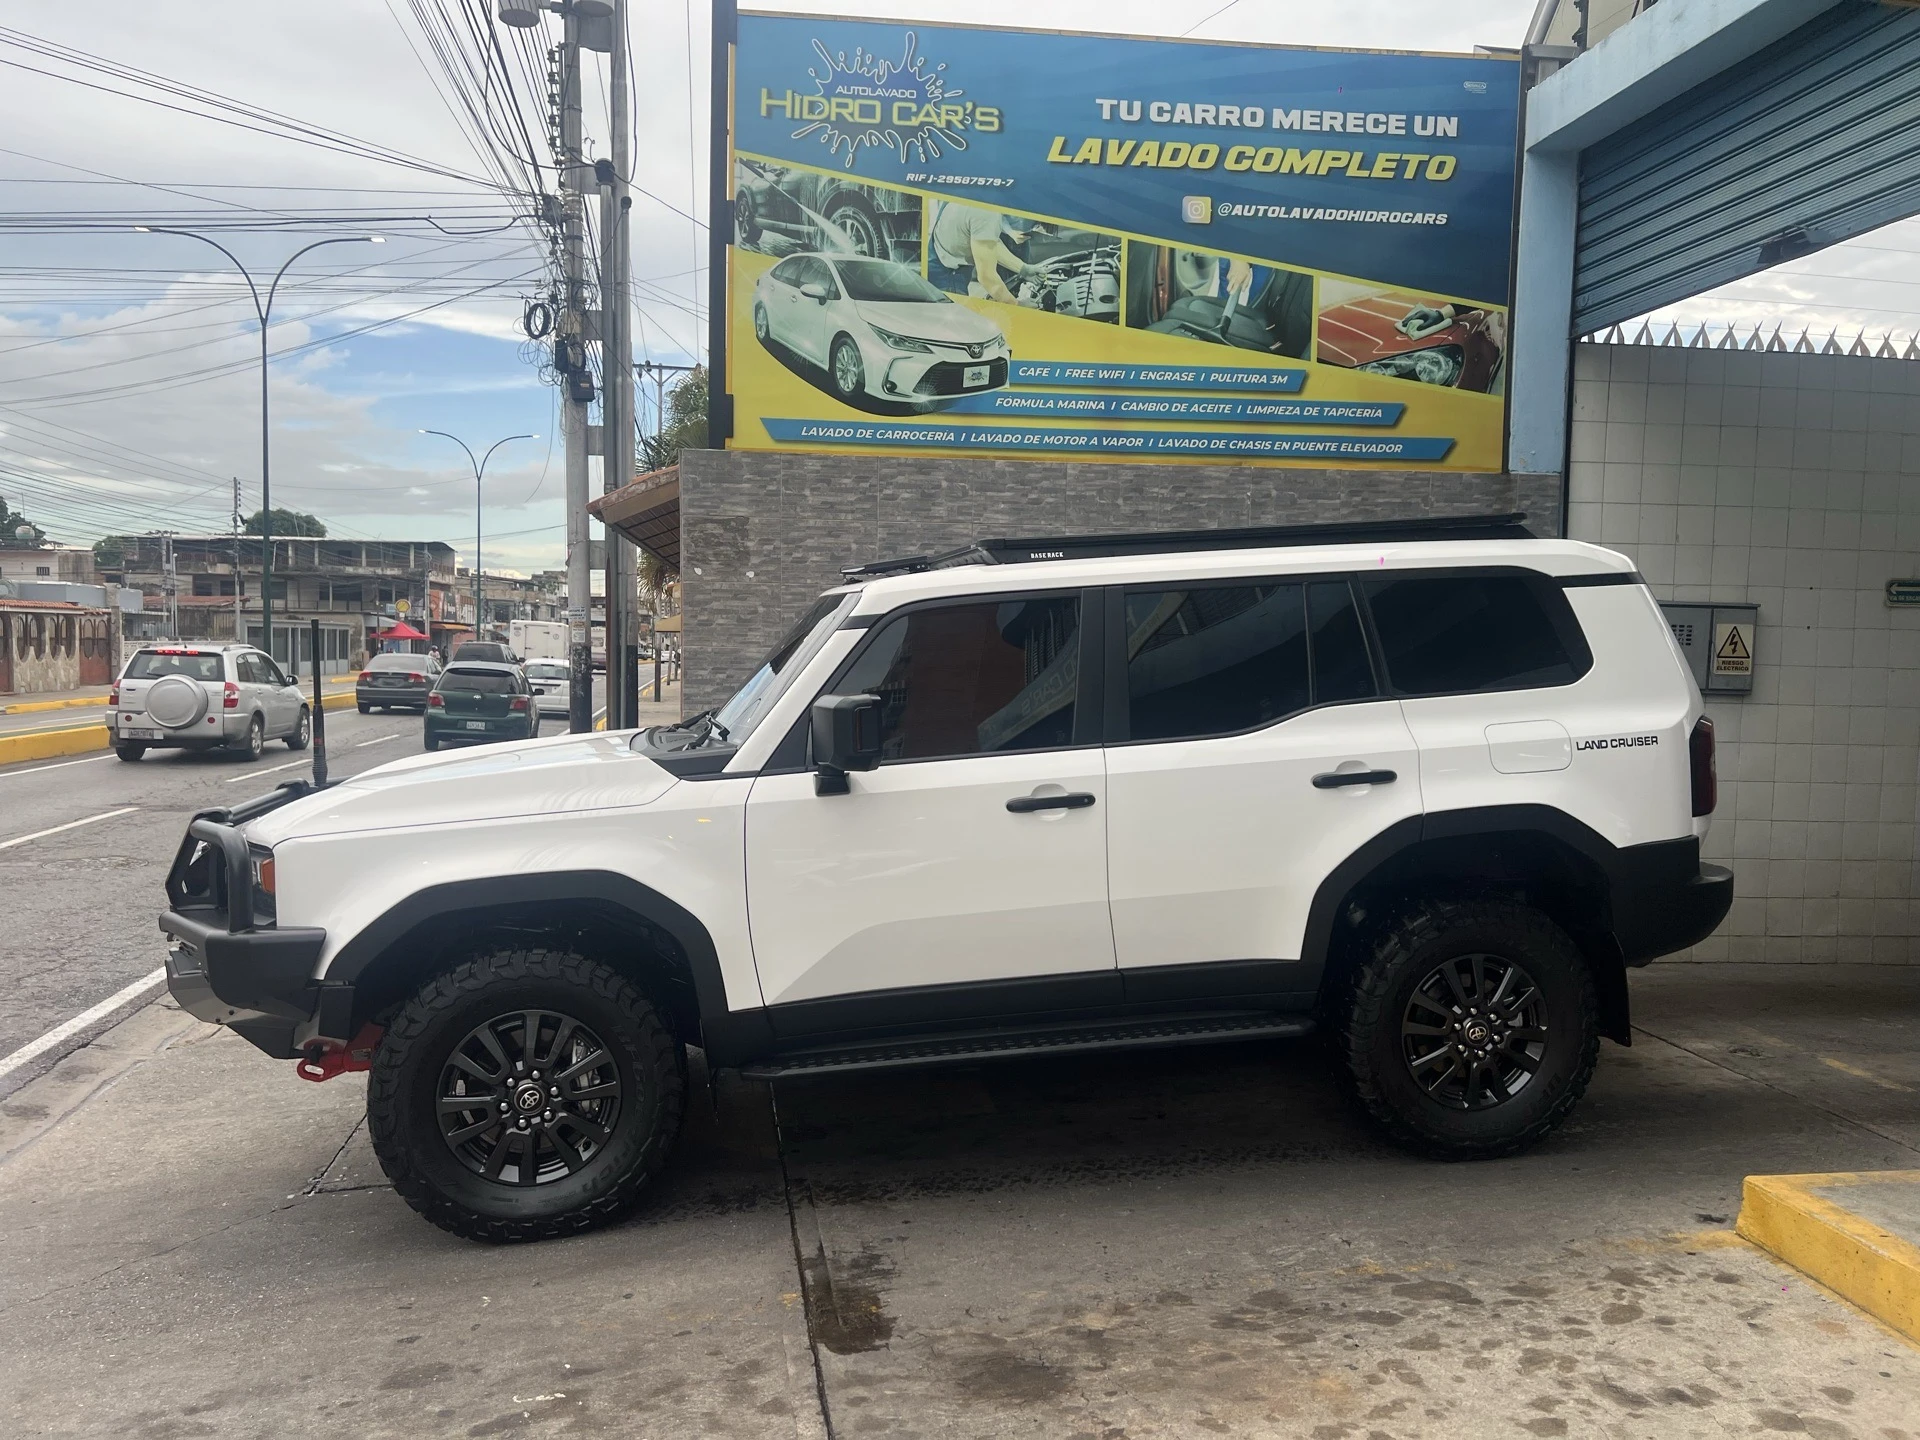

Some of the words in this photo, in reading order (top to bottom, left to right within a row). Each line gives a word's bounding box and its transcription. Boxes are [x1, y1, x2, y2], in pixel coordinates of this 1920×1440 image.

[836, 85, 917, 98] AUTOLAVADO
[760, 88, 881, 124] HIDRO
[892, 102, 1000, 131] CAR'S
[1096, 98, 1141, 120] TU
[1149, 101, 1264, 128] CARRO
[1272, 108, 1407, 135] MERECE
[1413, 115, 1458, 137] UN
[1046, 136, 1219, 170] LAVADO
[1224, 145, 1458, 181] COMPLETO
[906, 173, 927, 182] RIF
[1217, 202, 1448, 226] @AUTOLAVADOHIDROCARS
[1019, 366, 1050, 377] CAFÉ
[1065, 368, 1095, 379] FREE
[1099, 369, 1125, 380] WIFI
[1139, 371, 1196, 382] ENGRASE
[1210, 373, 1267, 384] PULITURA
[1269, 375, 1289, 385] 3M
[995, 396, 1054, 409] FÓRMULA
[1057, 400, 1105, 410] MARINA
[1121, 401, 1169, 412] CAMBIO
[1171, 403, 1188, 413] DE
[1190, 403, 1233, 414] ACEITE
[1246, 406, 1300, 416] LIMPIEZA
[1303, 407, 1321, 417] DE
[1323, 406, 1382, 418] TAPICERÍA
[801, 426, 854, 437] LAVADO
[856, 429, 874, 439] DE
[876, 429, 955, 441] CARROCERÍA
[970, 433, 1021, 444] LAVADO
[1024, 434, 1041, 444] DE
[1043, 435, 1089, 446] MOTOR
[1089, 436, 1098, 446] A
[1102, 436, 1144, 447] VAPOR
[1158, 438, 1208, 449] LAVADO
[1211, 439, 1228, 449] DE
[1229, 440, 1272, 450] CHASIS
[1274, 441, 1291, 451] EN
[1292, 441, 1338, 452] PUENTE
[1340, 443, 1403, 453] ELEVADOR
[1576, 738, 1608, 751] LAND
[1610, 735, 1659, 749] CRUISER
